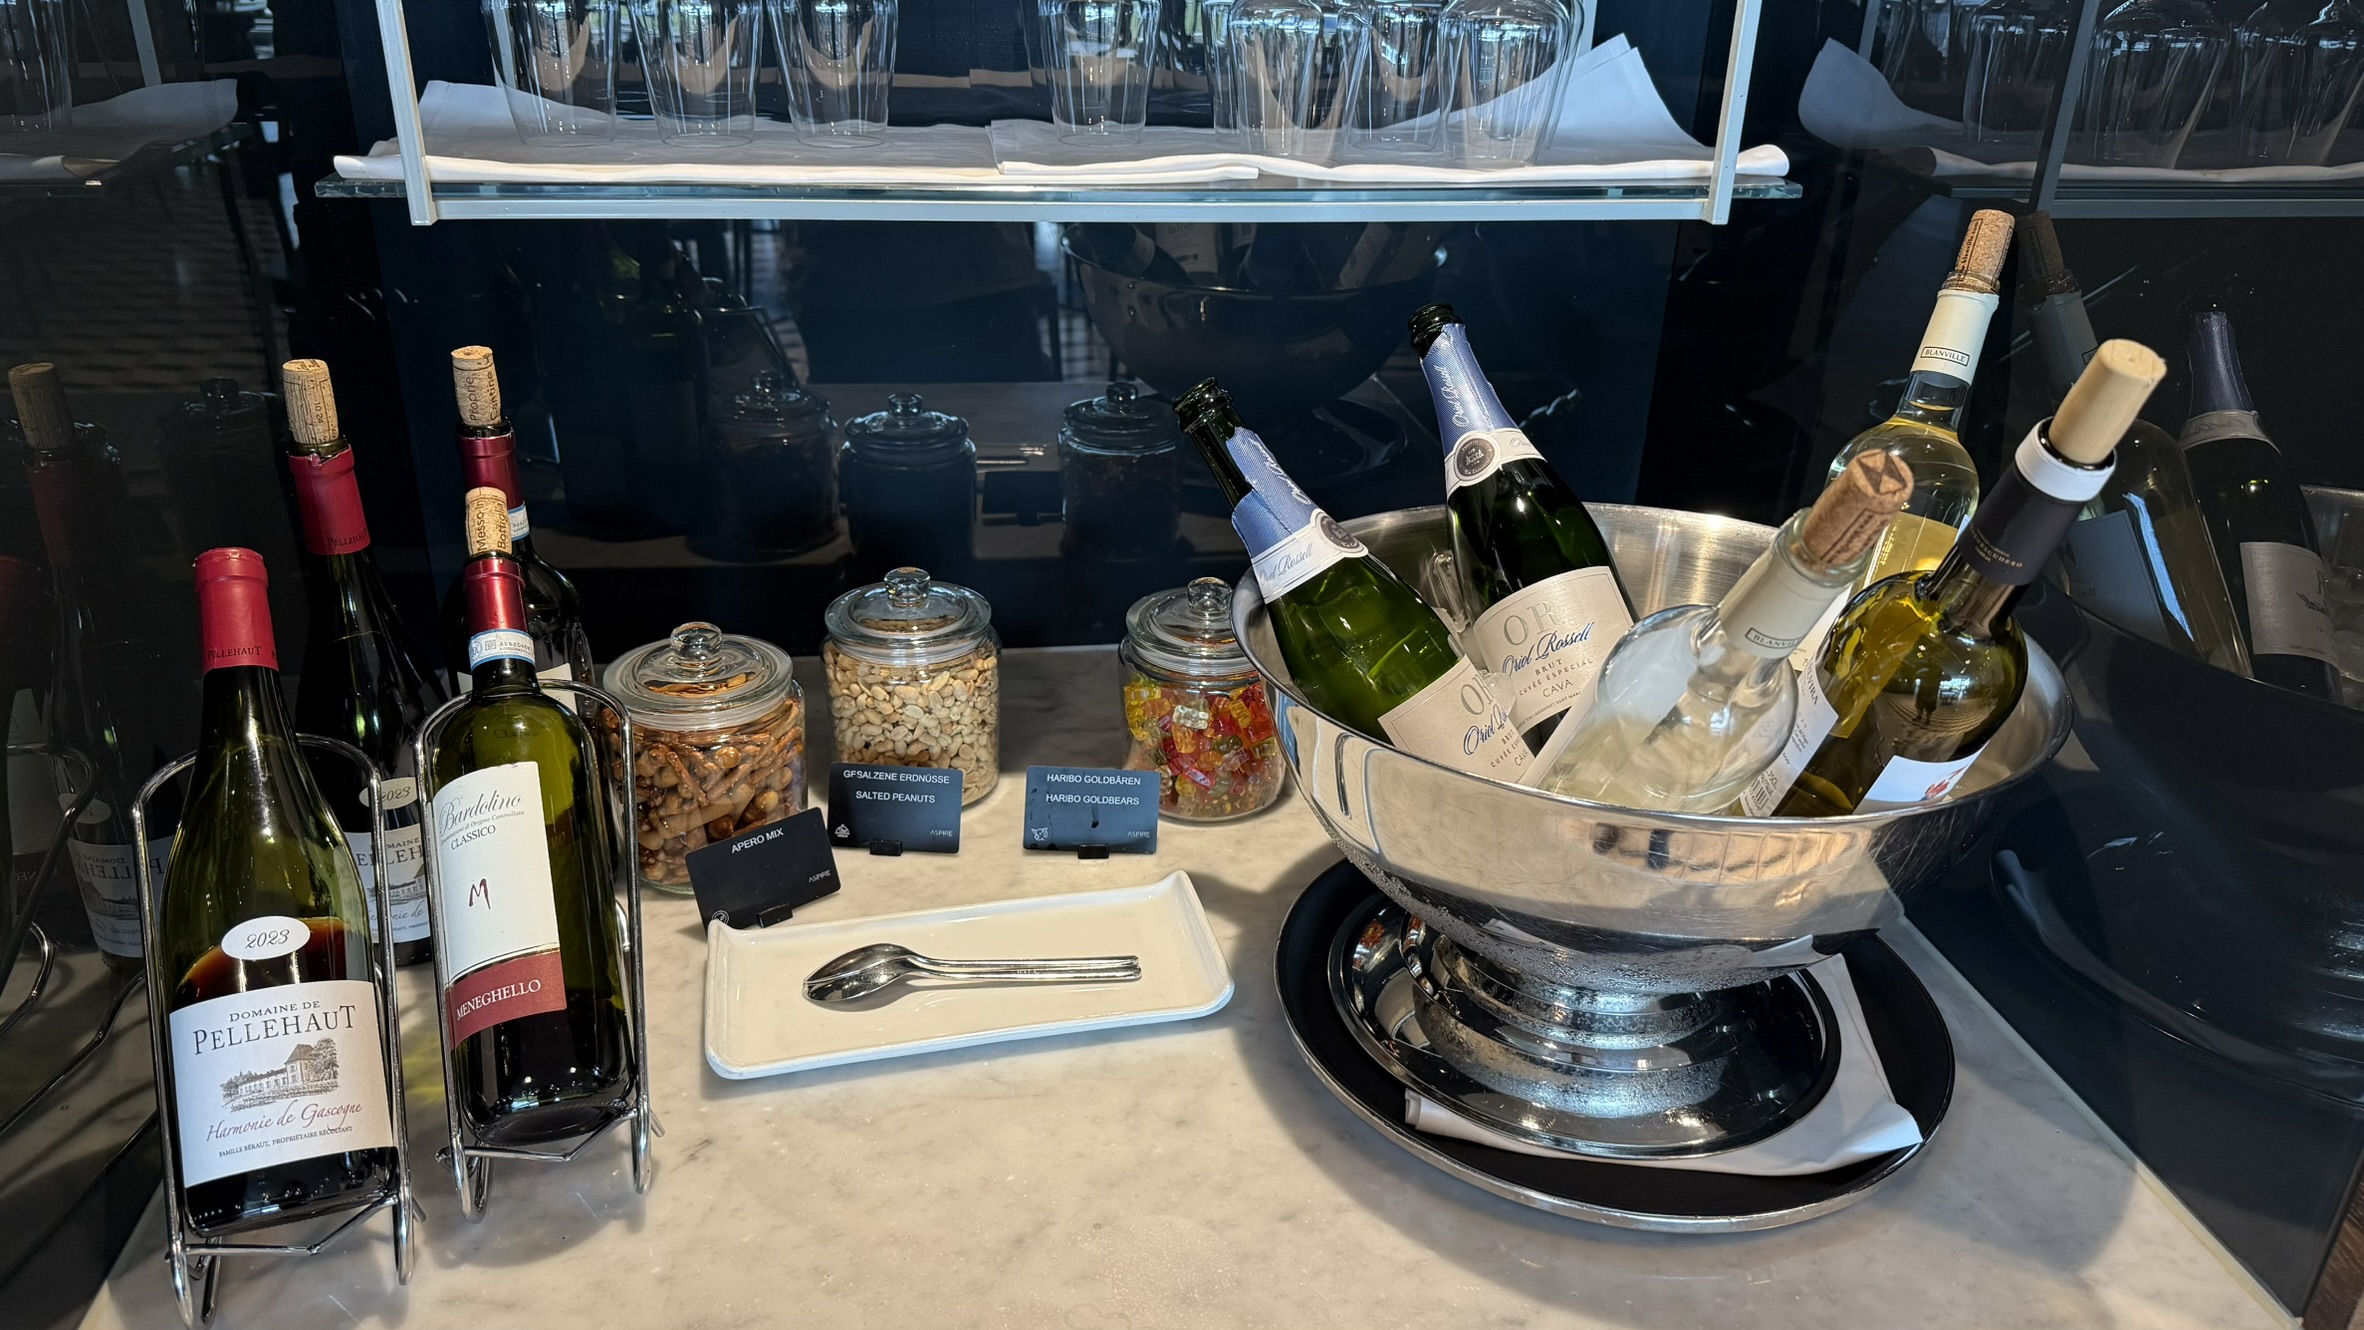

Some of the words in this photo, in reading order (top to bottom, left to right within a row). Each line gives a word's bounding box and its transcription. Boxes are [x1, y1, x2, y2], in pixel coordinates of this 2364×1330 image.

[1925, 349, 1966, 363] BLANVILLE
[464, 376, 479, 422] Proprie
[486, 371, 499, 422] Cantine
[326, 528, 368, 547] PELLEHAUT
[476, 511, 488, 552] Messo
[1535, 621, 1596, 662] Rossell
[1535, 658, 1563, 676] BRUT
[1546, 658, 1594, 681] ESPECIAL
[1542, 678, 1574, 698] CAVA
[899, 772, 950, 785] ERDNÜSSE
[1046, 773, 1082, 784] HARIBO
[1083, 774, 1141, 786] GOLDBÄREN
[855, 790, 891, 801] SALTED
[892, 792, 936, 804] PEANUTS
[1045, 793, 1081, 804] HARIBO
[1082, 794, 1140, 806] GOLDBEARS
[440, 789, 524, 838] Bardolino
[450, 824, 497, 851] CLASSICO
[731, 834, 766, 855] APERO
[765, 827, 785, 842] MIX
[929, 829, 954, 838] ASPIRE
[1127, 831, 1151, 839] ASPIRE
[808, 868, 832, 884] ASPIRE
[468, 878, 492, 911] M
[246, 929, 291, 950] 2023
[229, 1003, 299, 1023] DOMAINE
[302, 1000, 321, 1010] DE
[456, 979, 543, 1021] MENEGHELLO
[193, 1004, 357, 1056] PELLEHAUT
[206, 1114, 274, 1142] Harmonie
[276, 1099, 299, 1127] de
[301, 1101, 363, 1132] Gascogne
[219, 1145, 243, 1158] FAMILLE
[243, 1139, 271, 1153] BÉRAUT,
[272, 1130, 318, 1146] PROPRIÉTAIRE
[318, 1125, 354, 1138] RÉCOLTANT
